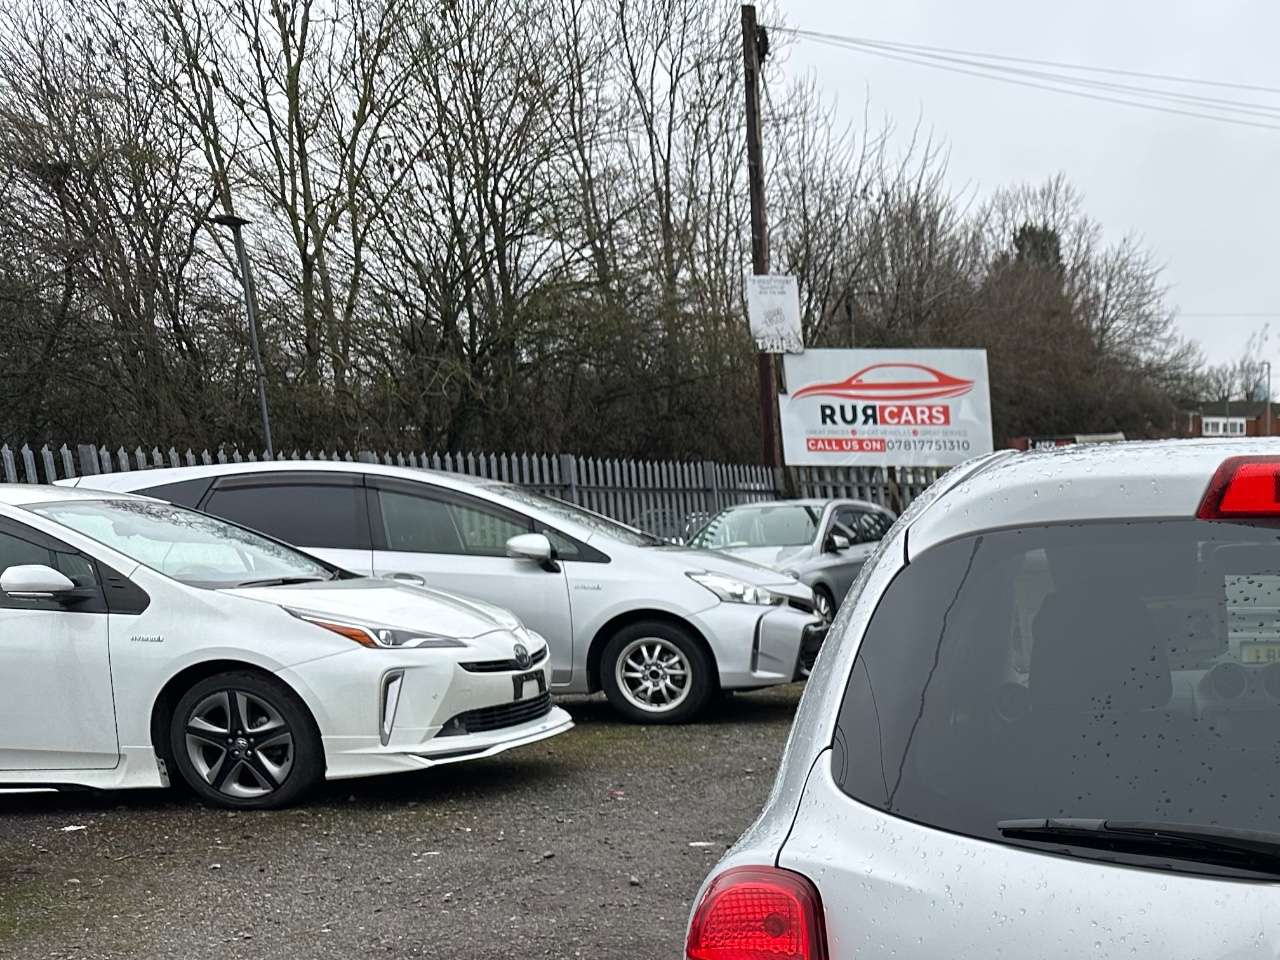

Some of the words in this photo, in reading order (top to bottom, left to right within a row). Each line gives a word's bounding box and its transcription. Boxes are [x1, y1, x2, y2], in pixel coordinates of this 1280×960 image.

[883, 406, 946, 425] CARS
[808, 440, 840, 450] CALL
[842, 440, 859, 450] US
[886, 439, 970, 451] 07817751310
